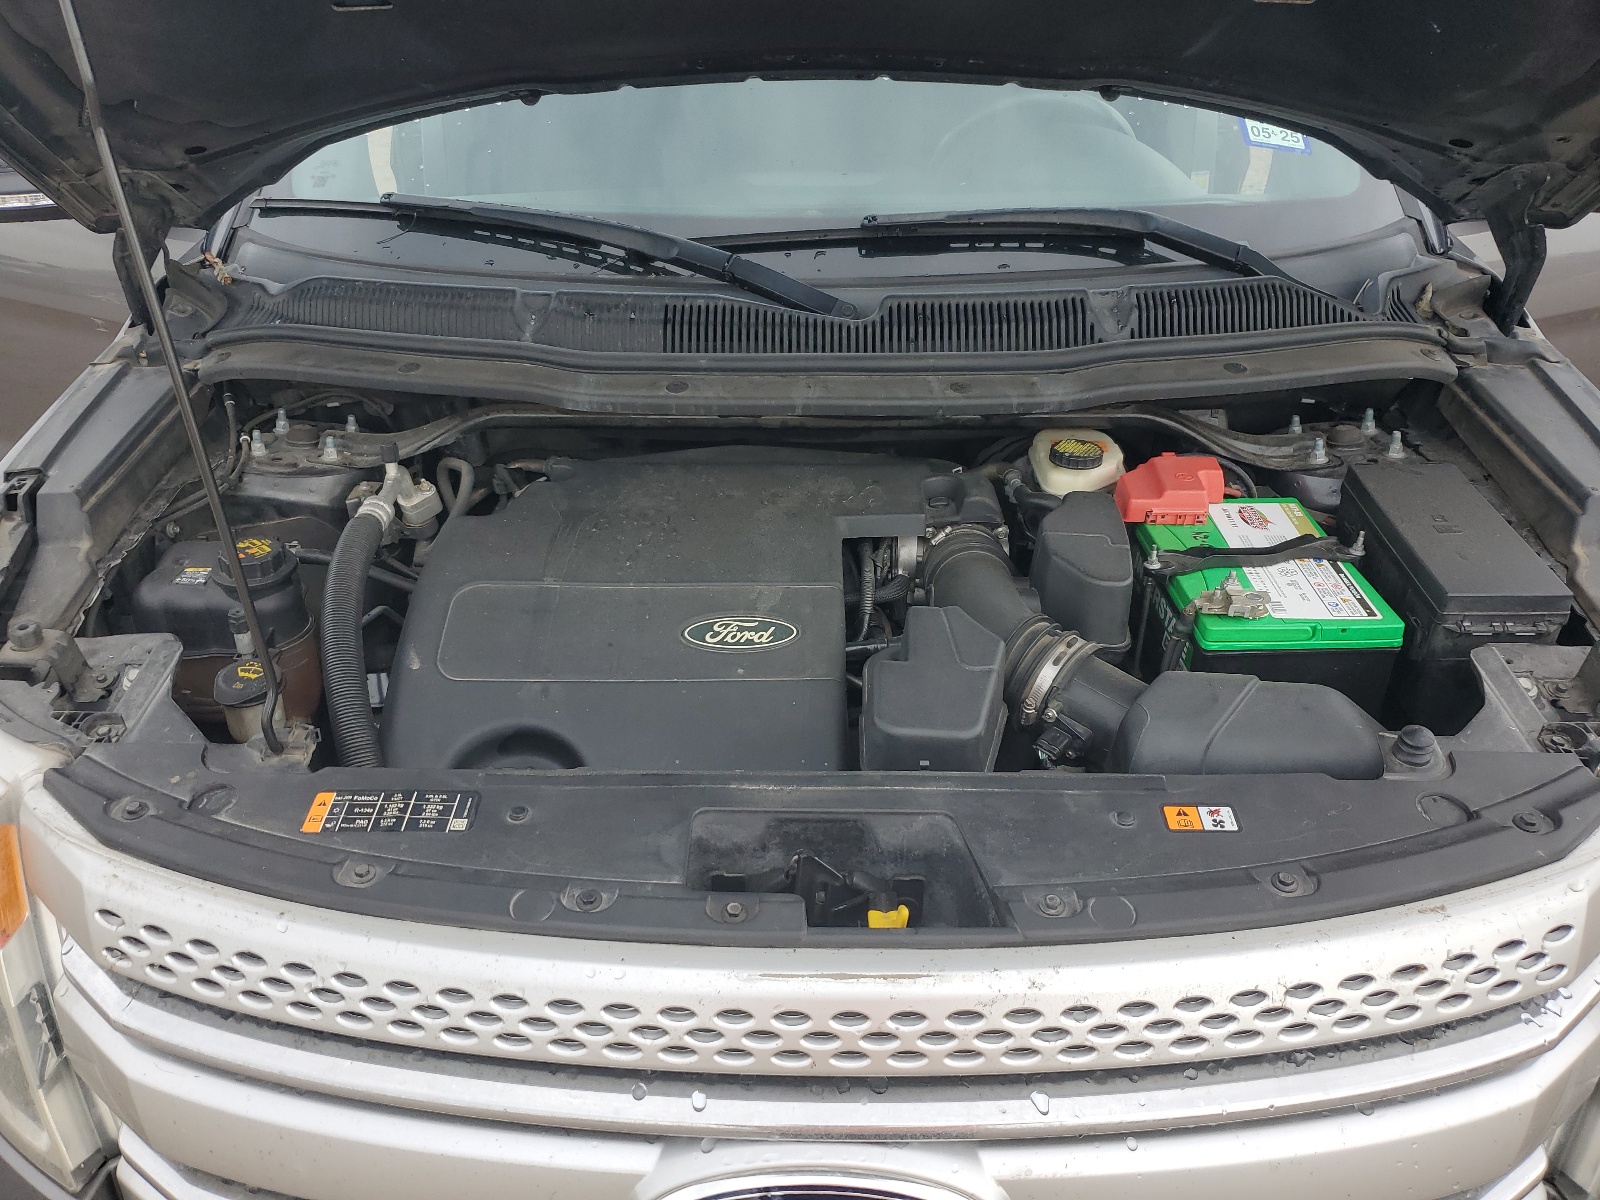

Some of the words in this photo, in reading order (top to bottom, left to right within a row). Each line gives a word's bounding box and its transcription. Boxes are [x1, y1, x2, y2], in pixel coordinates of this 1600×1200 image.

[1250, 125, 1271, 139] 05
[1279, 129, 1301, 143] 25
[705, 621, 775, 643] Ford
